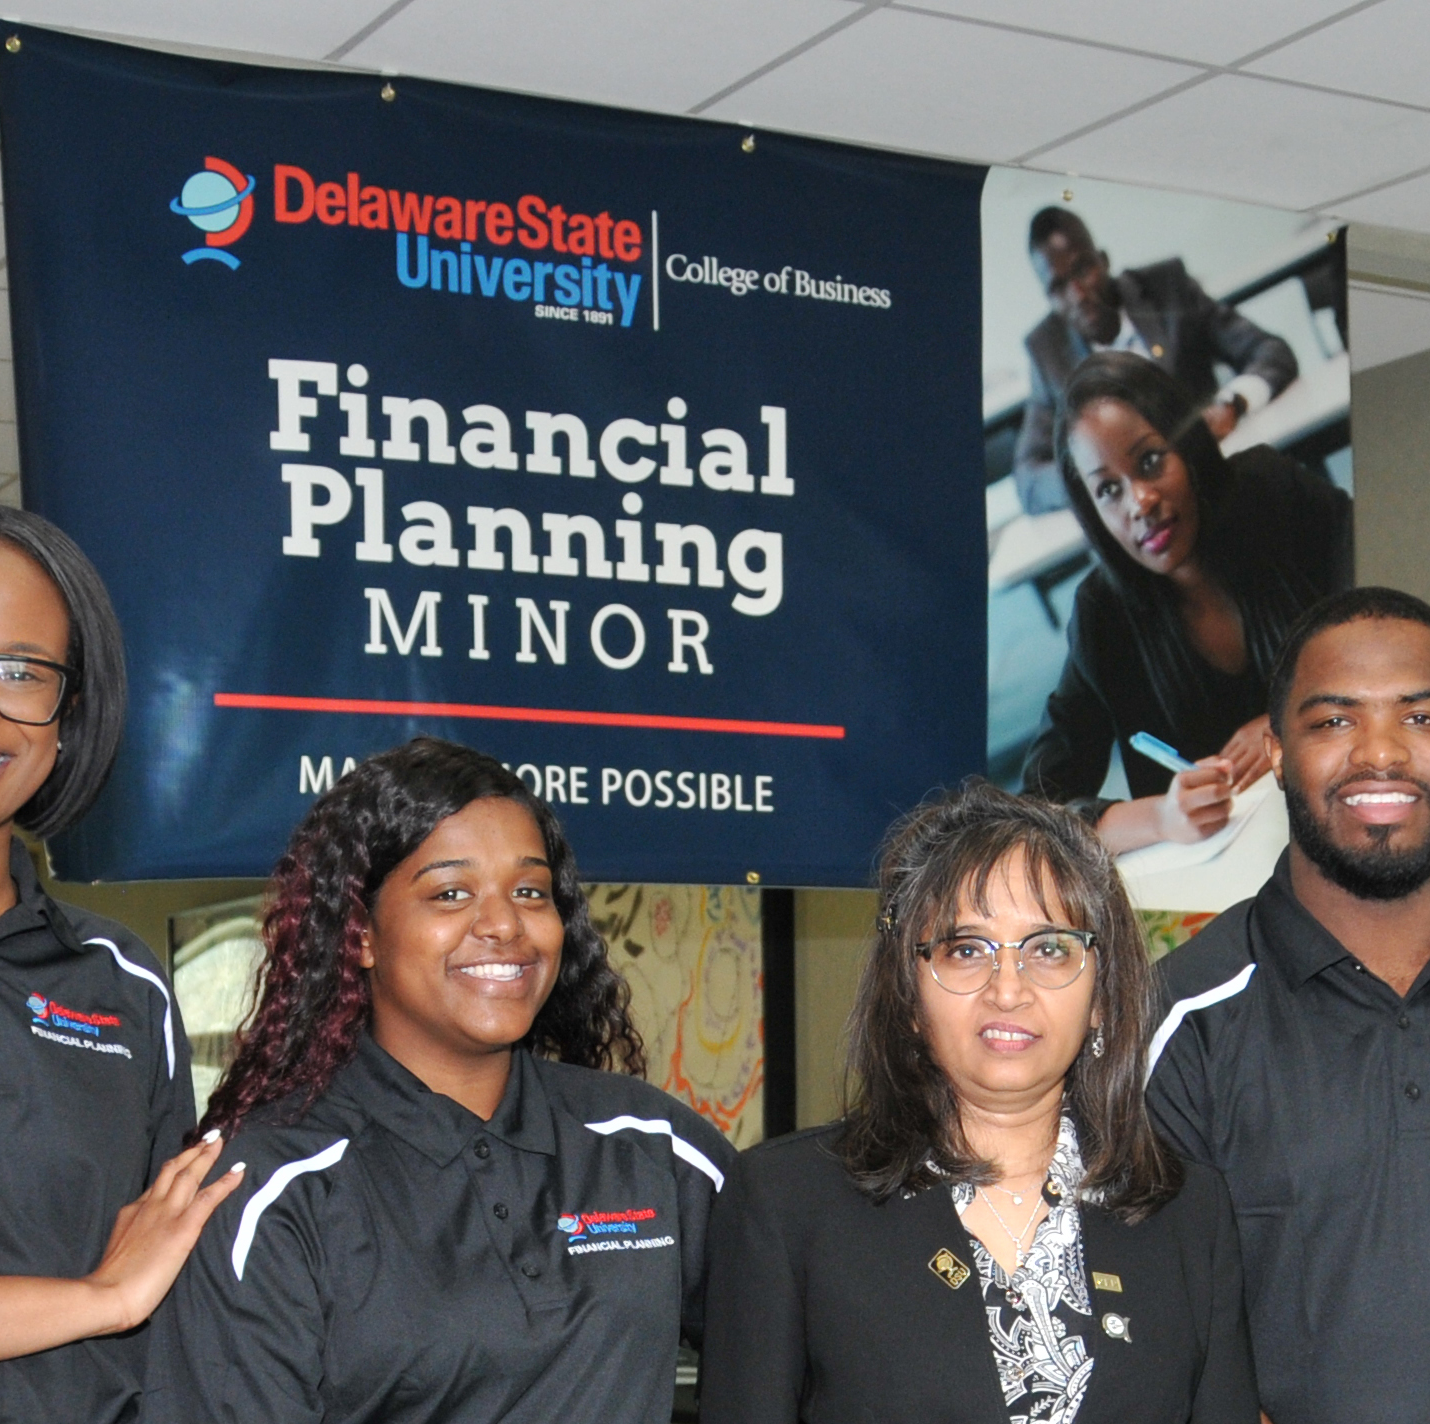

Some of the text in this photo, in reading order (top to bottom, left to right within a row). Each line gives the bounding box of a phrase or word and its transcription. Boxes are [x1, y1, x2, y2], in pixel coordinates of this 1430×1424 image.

[396, 232, 641, 328] University
[666, 253, 892, 309] College of Business
[535, 304, 613, 326] SINCE 1891
[268, 358, 795, 496] Financial
[281, 463, 783, 617] Planning
[364, 587, 714, 675] MINOR
[501, 762, 775, 813] ORE POSSIBLE
[567, 1235, 675, 1256] FINANCIAL PLANNING
[587, 1221, 638, 1235] University
